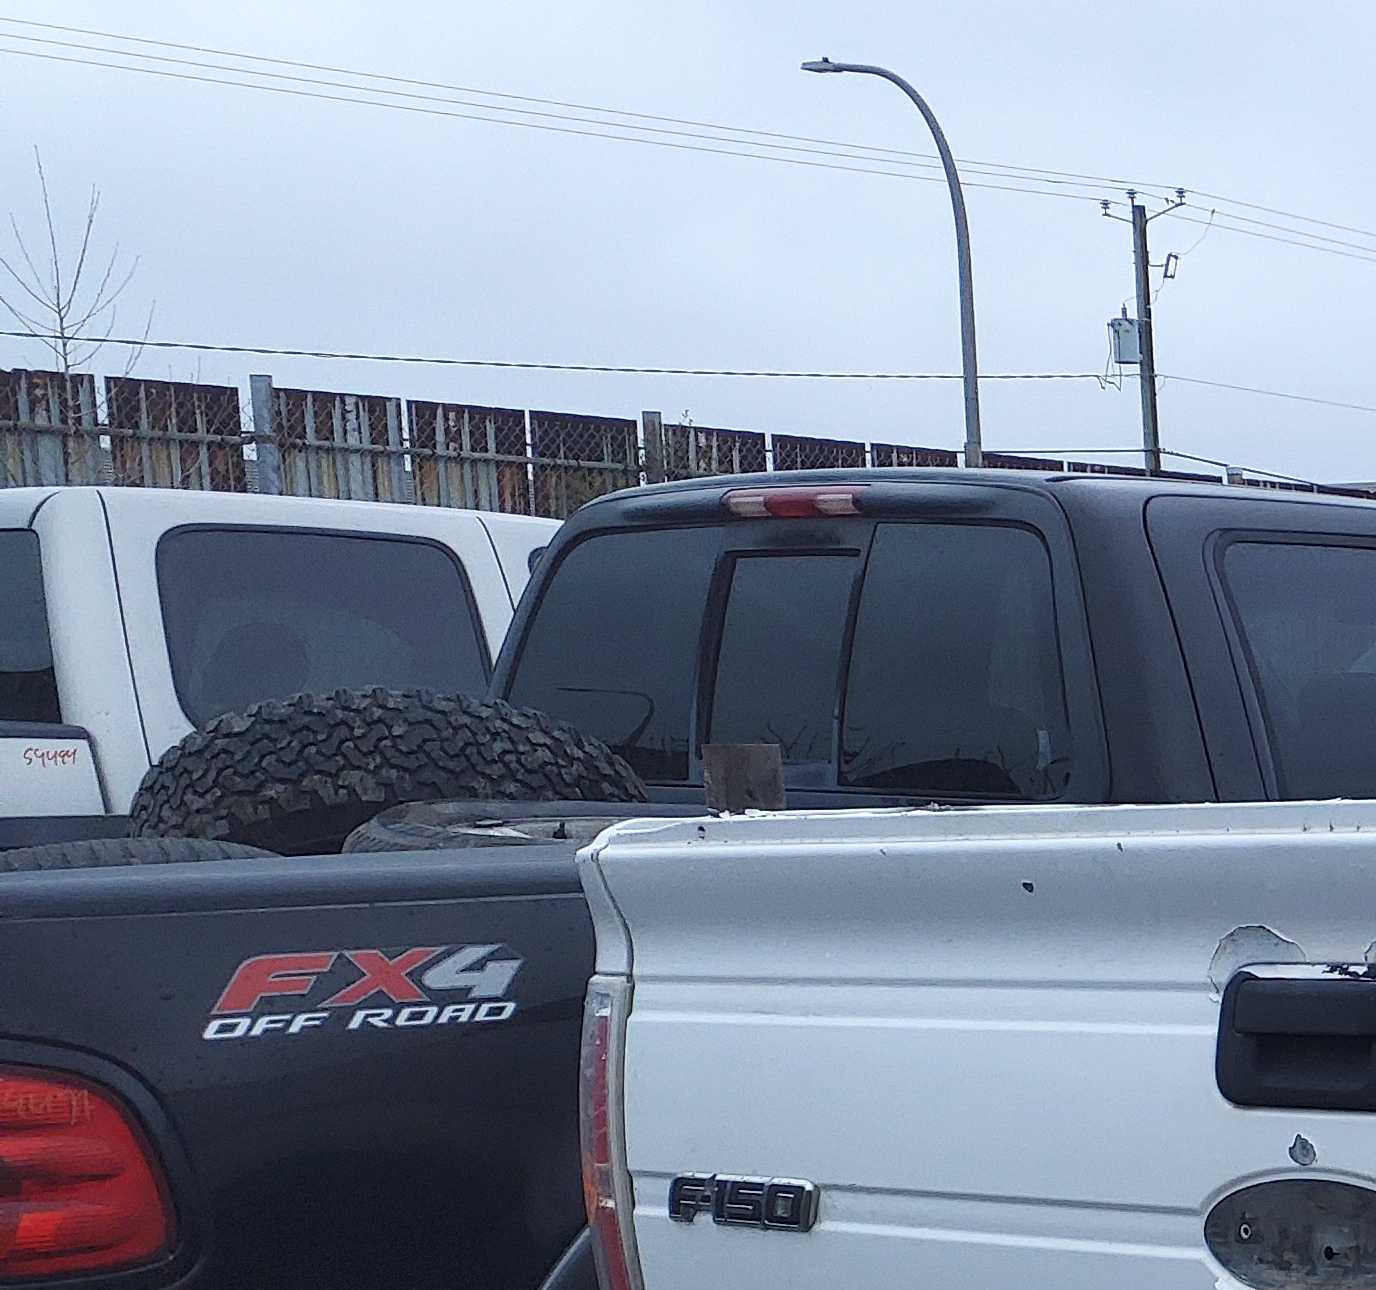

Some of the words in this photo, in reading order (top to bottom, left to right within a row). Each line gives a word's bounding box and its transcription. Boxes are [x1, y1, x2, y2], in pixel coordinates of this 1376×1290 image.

[210, 943, 524, 1015] FX4
[202, 1010, 330, 1041] OFF
[345, 1001, 518, 1031] ROAD
